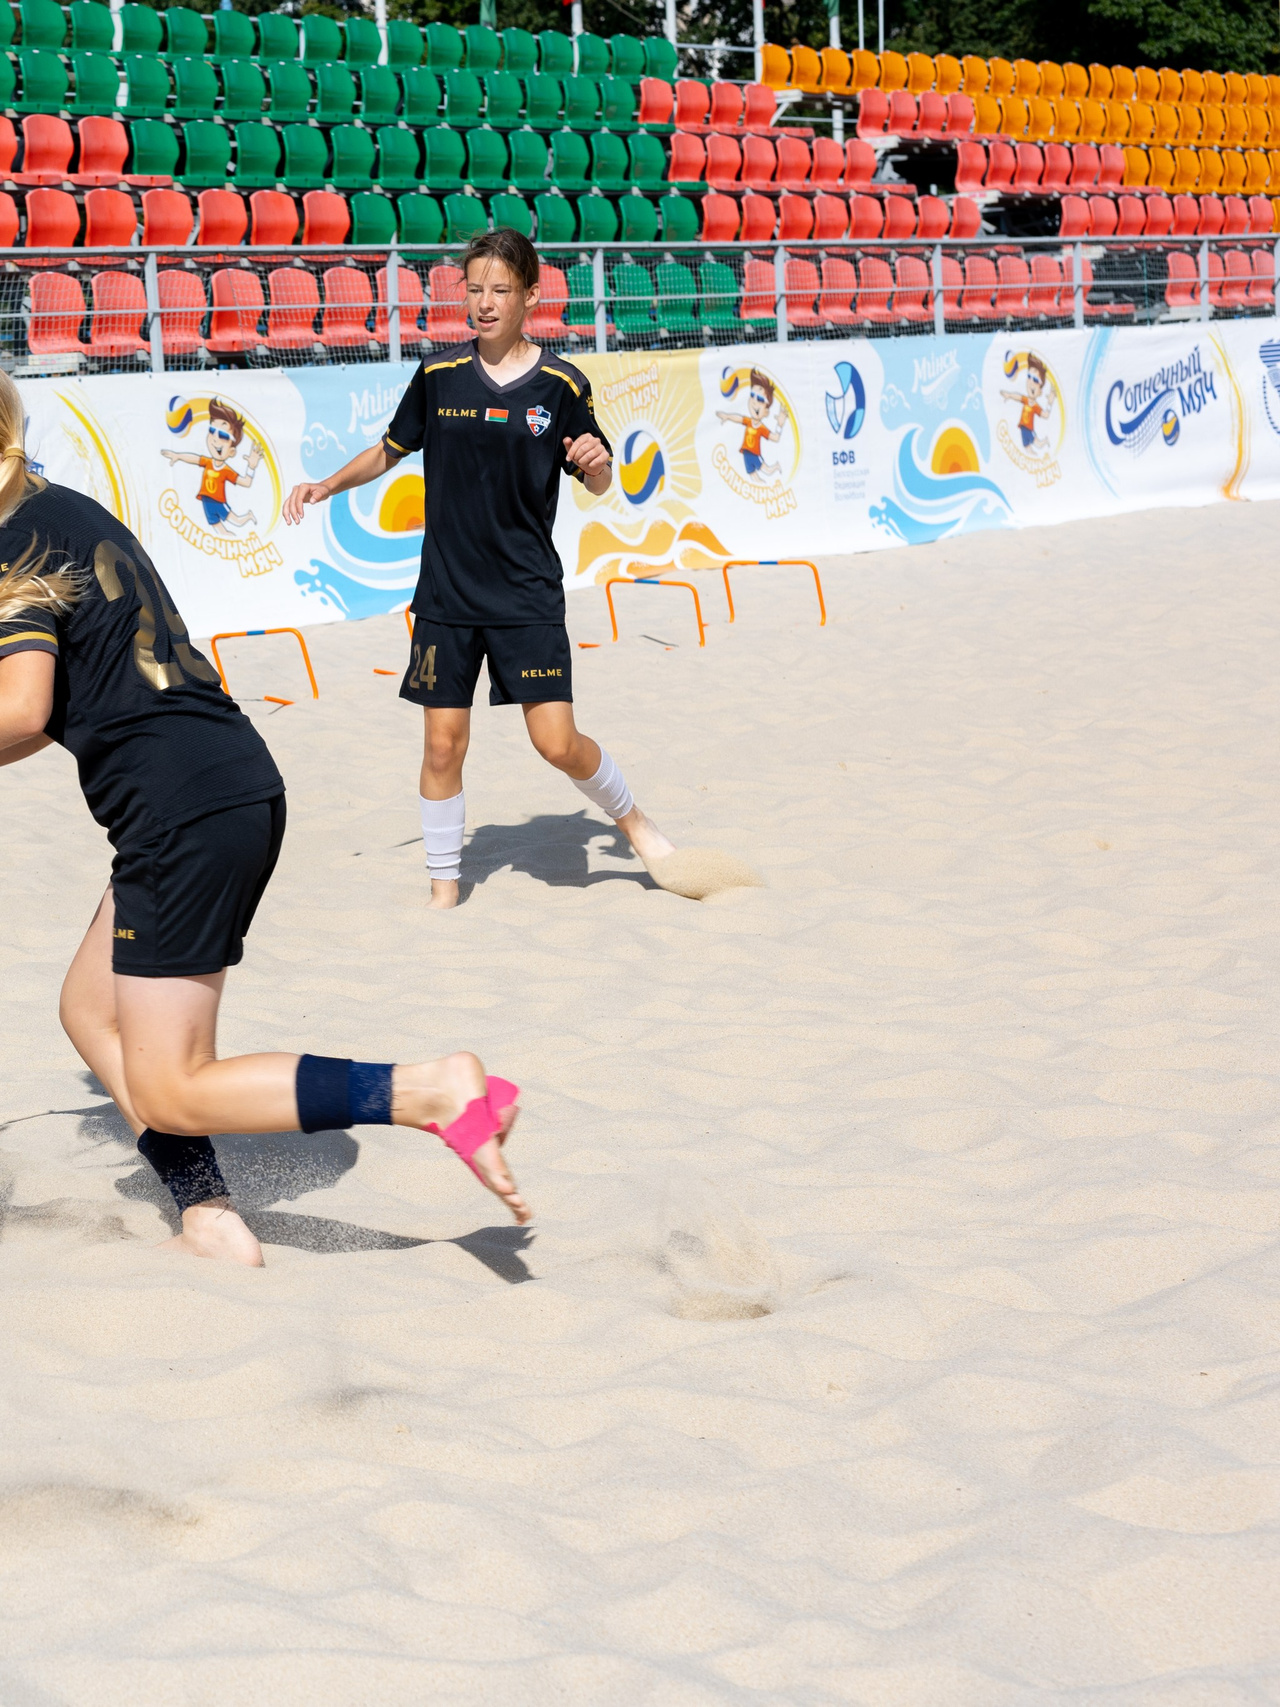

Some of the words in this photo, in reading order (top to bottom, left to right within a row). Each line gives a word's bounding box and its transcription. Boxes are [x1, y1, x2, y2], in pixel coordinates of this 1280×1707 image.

[438, 407, 478, 418] KELME
[1106, 344, 1202, 445] Солнечный
[711, 442, 786, 505] Солнечный
[832, 450, 855, 466] БФВ
[158, 488, 262, 561] Солнечный
[408, 643, 438, 691] 24
[521, 668, 563, 678] KELME
